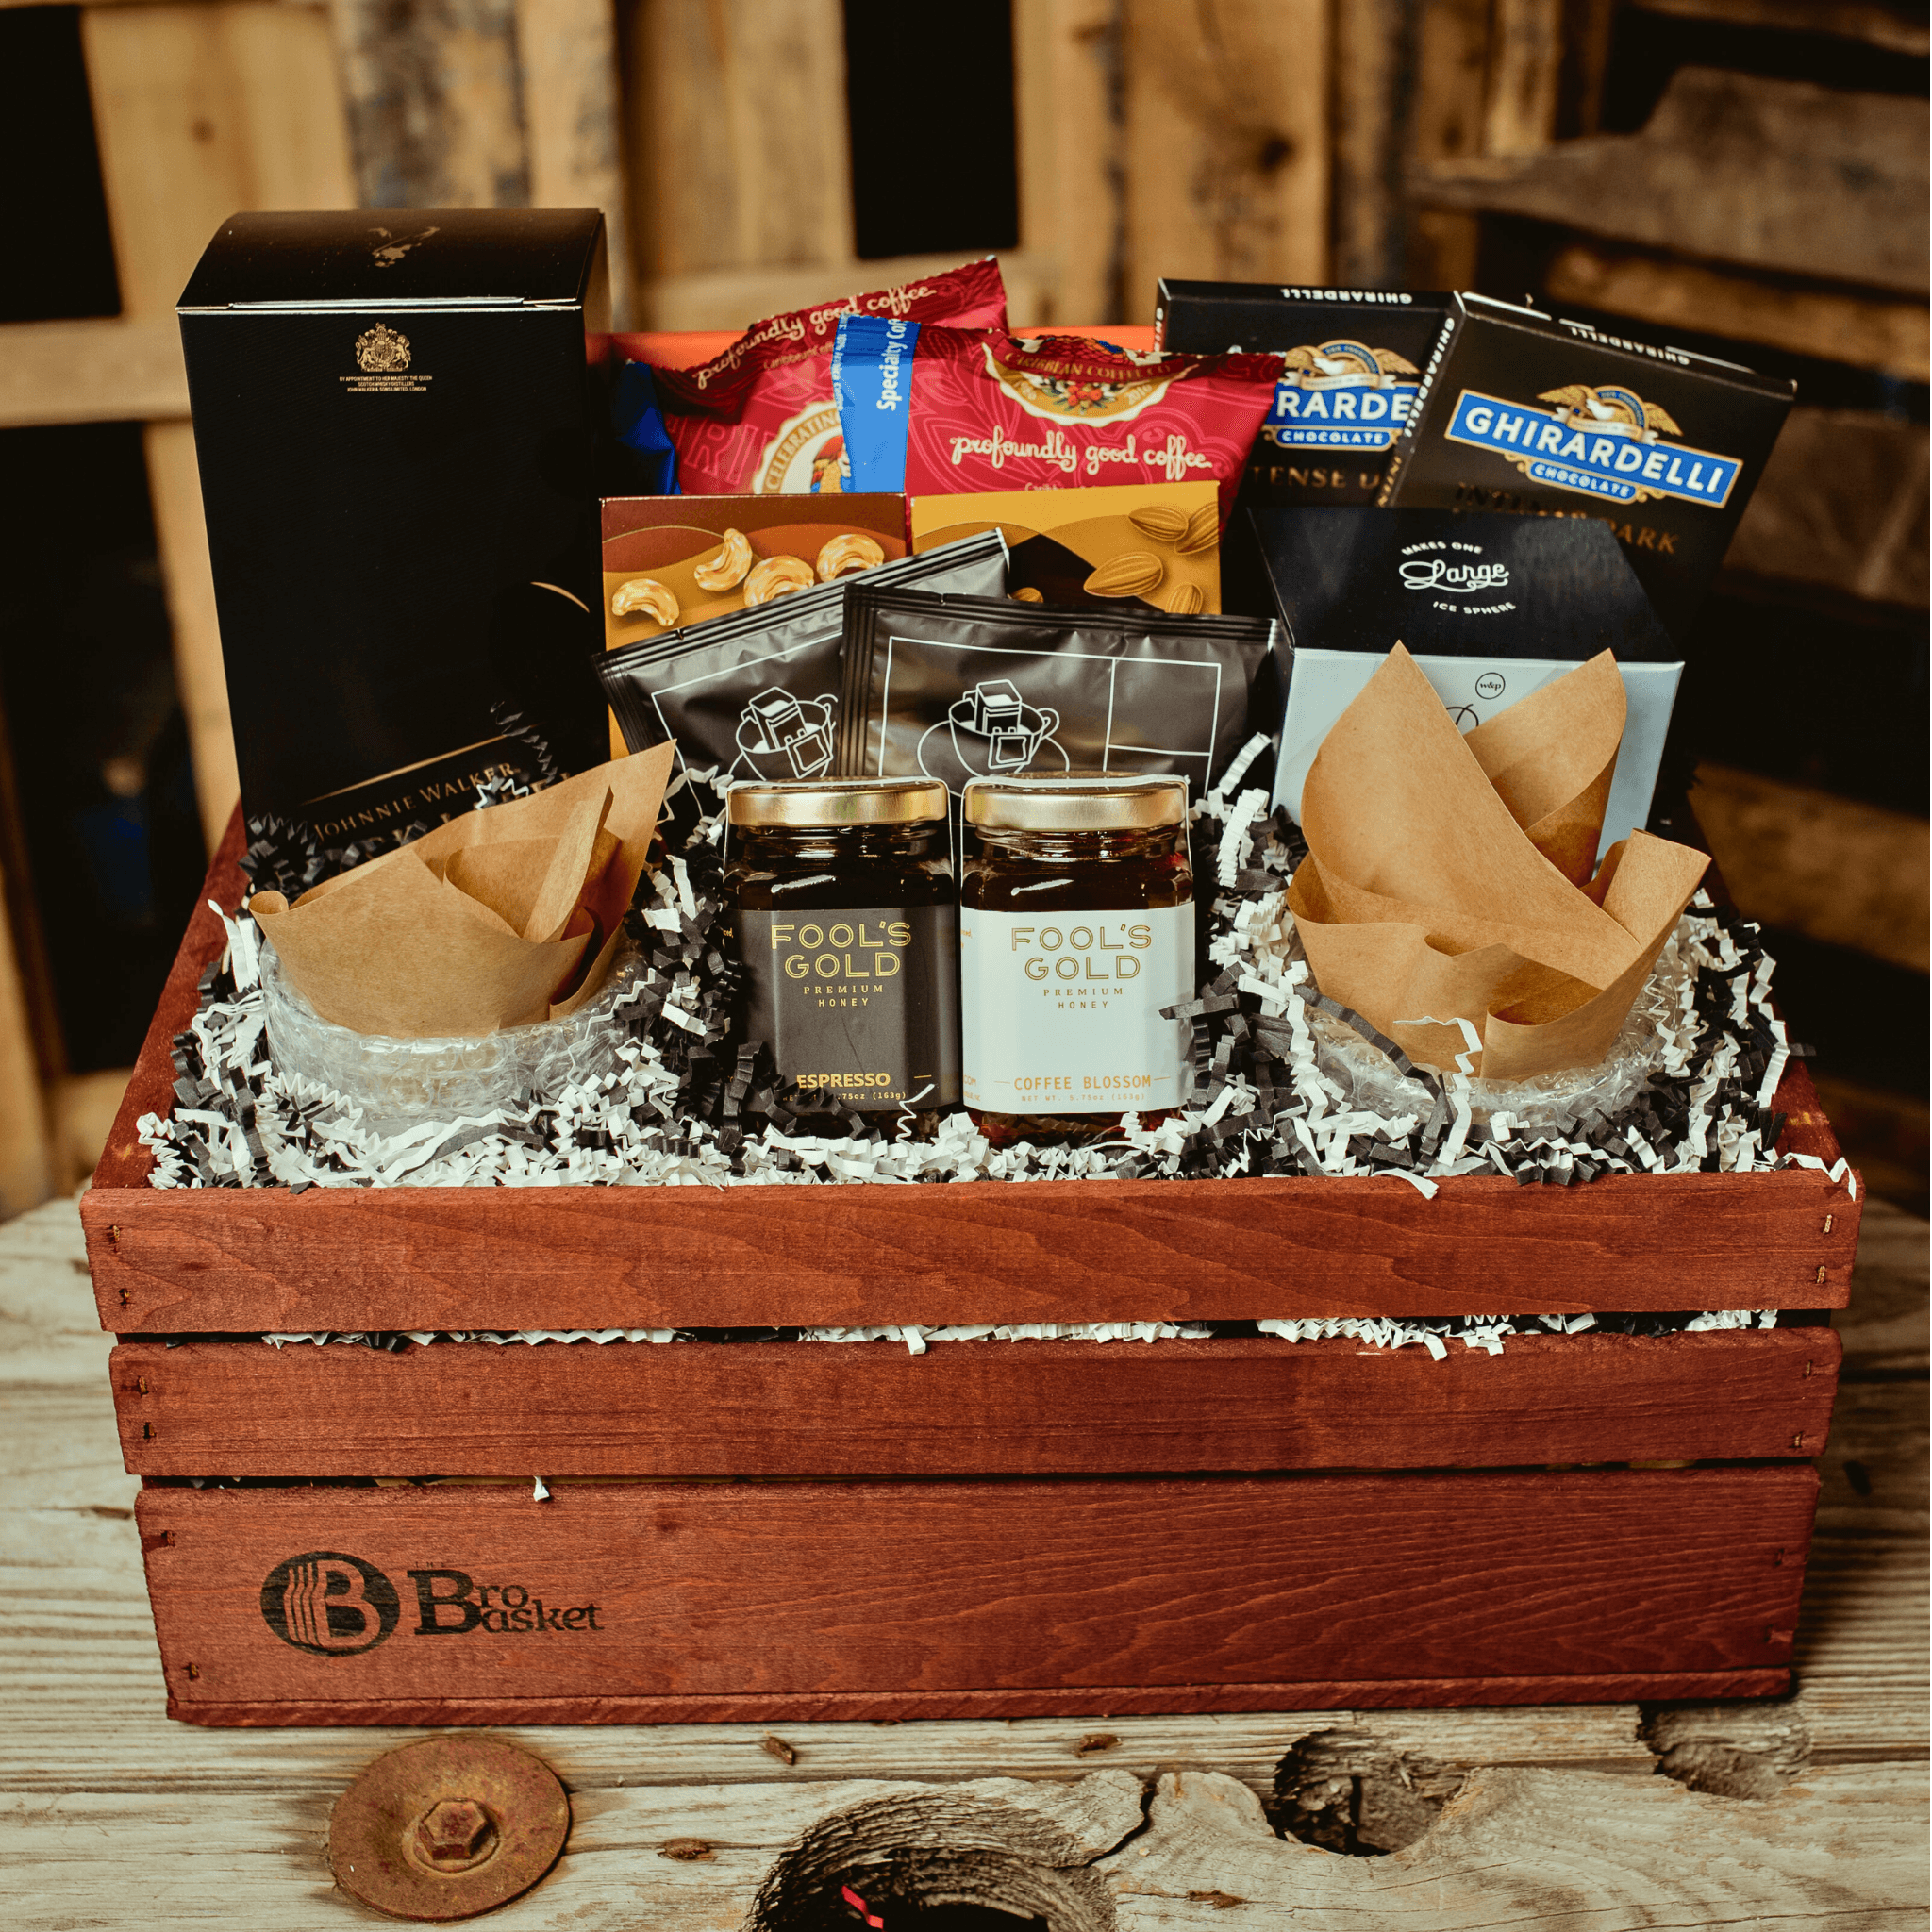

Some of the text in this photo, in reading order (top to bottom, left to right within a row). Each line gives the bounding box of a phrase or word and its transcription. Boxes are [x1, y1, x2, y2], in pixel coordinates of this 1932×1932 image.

[1280, 288, 1413, 305] GHIRARDELLI
[691, 316, 806, 389] profoundly
[808, 294, 862, 336] good
[866, 284, 937, 316] coffee
[1569, 325, 1690, 366] GHIRARDELLI
[875, 341, 908, 412] Specialty
[1281, 429, 1384, 445] CHOCOLATE
[949, 425, 1213, 481] profoundly good coffee
[1464, 406, 1725, 495] GHIRARDELLI
[1534, 463, 1631, 499] CHOCOLATE
[1451, 541, 1483, 555] ONE
[1398, 558, 1510, 593] Large
[1432, 601, 1517, 615] ICE SPHERE
[1479, 680, 1502, 691] w&p
[313, 794, 417, 842] JOHNNIE
[770, 920, 912, 950] FOOL'S
[1010, 924, 1152, 951] FOOL'S
[784, 951, 901, 979] GOLD
[1024, 955, 1141, 981] GOLD
[803, 984, 884, 995] PREMIUM
[1042, 987, 1124, 997] PREMIUM
[817, 997, 870, 1008] HONEY
[1058, 1000, 1109, 1009] HONEY
[796, 1072, 891, 1089] ESPRESSO
[1013, 1074, 1151, 1091] COFFEE BLOSSOM
[872, 1091, 907, 1101] (163g)
